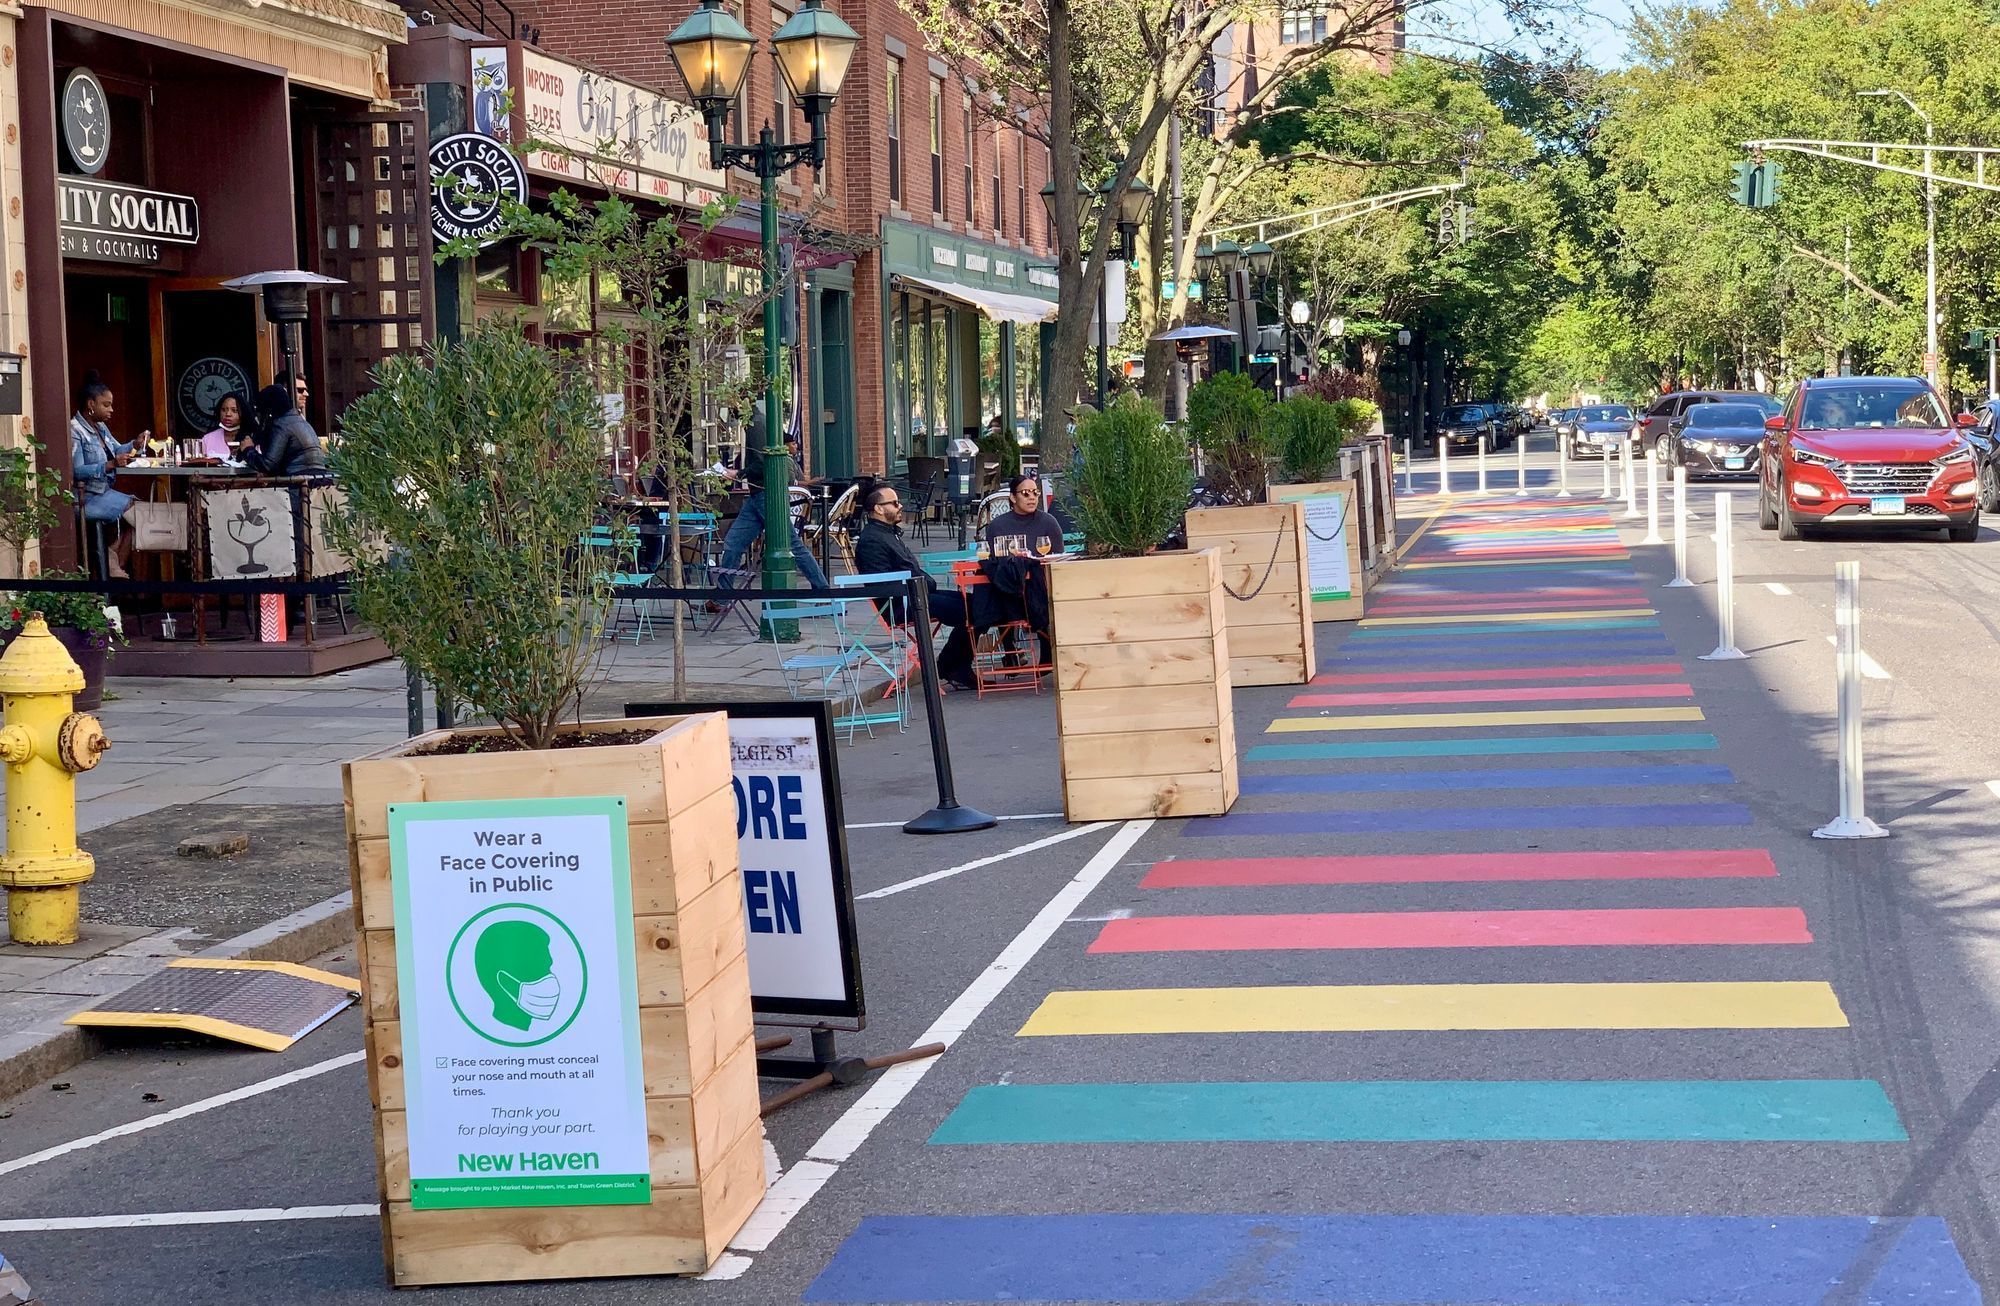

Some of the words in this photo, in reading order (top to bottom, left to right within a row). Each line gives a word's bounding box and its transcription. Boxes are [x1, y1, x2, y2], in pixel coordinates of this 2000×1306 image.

[526, 66, 564, 98] IMPORTED
[532, 103, 561, 131] PIPES
[577, 75, 618, 137] Owl
[651, 100, 687, 173] Shop
[437, 141, 471, 166] CITY
[475, 143, 517, 195] SOCIAL
[540, 150, 570, 174] CIGAR
[653, 178, 669, 196] AND
[698, 189, 713, 205] BAR
[59, 185, 102, 225] ITY
[109, 193, 193, 236] SOCIAL
[430, 204, 461, 237] KITCHEN
[461, 228, 470, 239] &
[82, 237, 89, 252] &
[95, 239, 158, 260] COCKTAILS
[775, 744, 797, 761] ST
[473, 831, 526, 847] Wear
[531, 833, 542, 846] a
[440, 855, 486, 871] Face
[491, 852, 580, 872] Covering
[469, 877, 487, 893] in
[492, 876, 553, 893] Public
[743, 870, 802, 934] EN
[451, 1057, 477, 1068] Face
[478, 1056, 525, 1068] covering
[527, 1056, 555, 1066] must
[557, 1054, 599, 1065] conceal
[451, 1072, 476, 1084] your
[478, 1072, 505, 1081] nose
[506, 1069, 528, 1081] and
[530, 1069, 566, 1080] mouth
[568, 1070, 580, 1080] at
[581, 1068, 595, 1079] all
[452, 1086, 486, 1097] times.
[491, 1106, 534, 1119] Thank
[535, 1107, 561, 1121] you
[457, 1123, 476, 1136] for
[478, 1123, 529, 1138] playing
[531, 1123, 563, 1137] your
[563, 1122, 596, 1137] part.
[458, 1153, 514, 1172] New
[519, 1151, 600, 1171] Haven
[450, 1185, 474, 1193] brought
